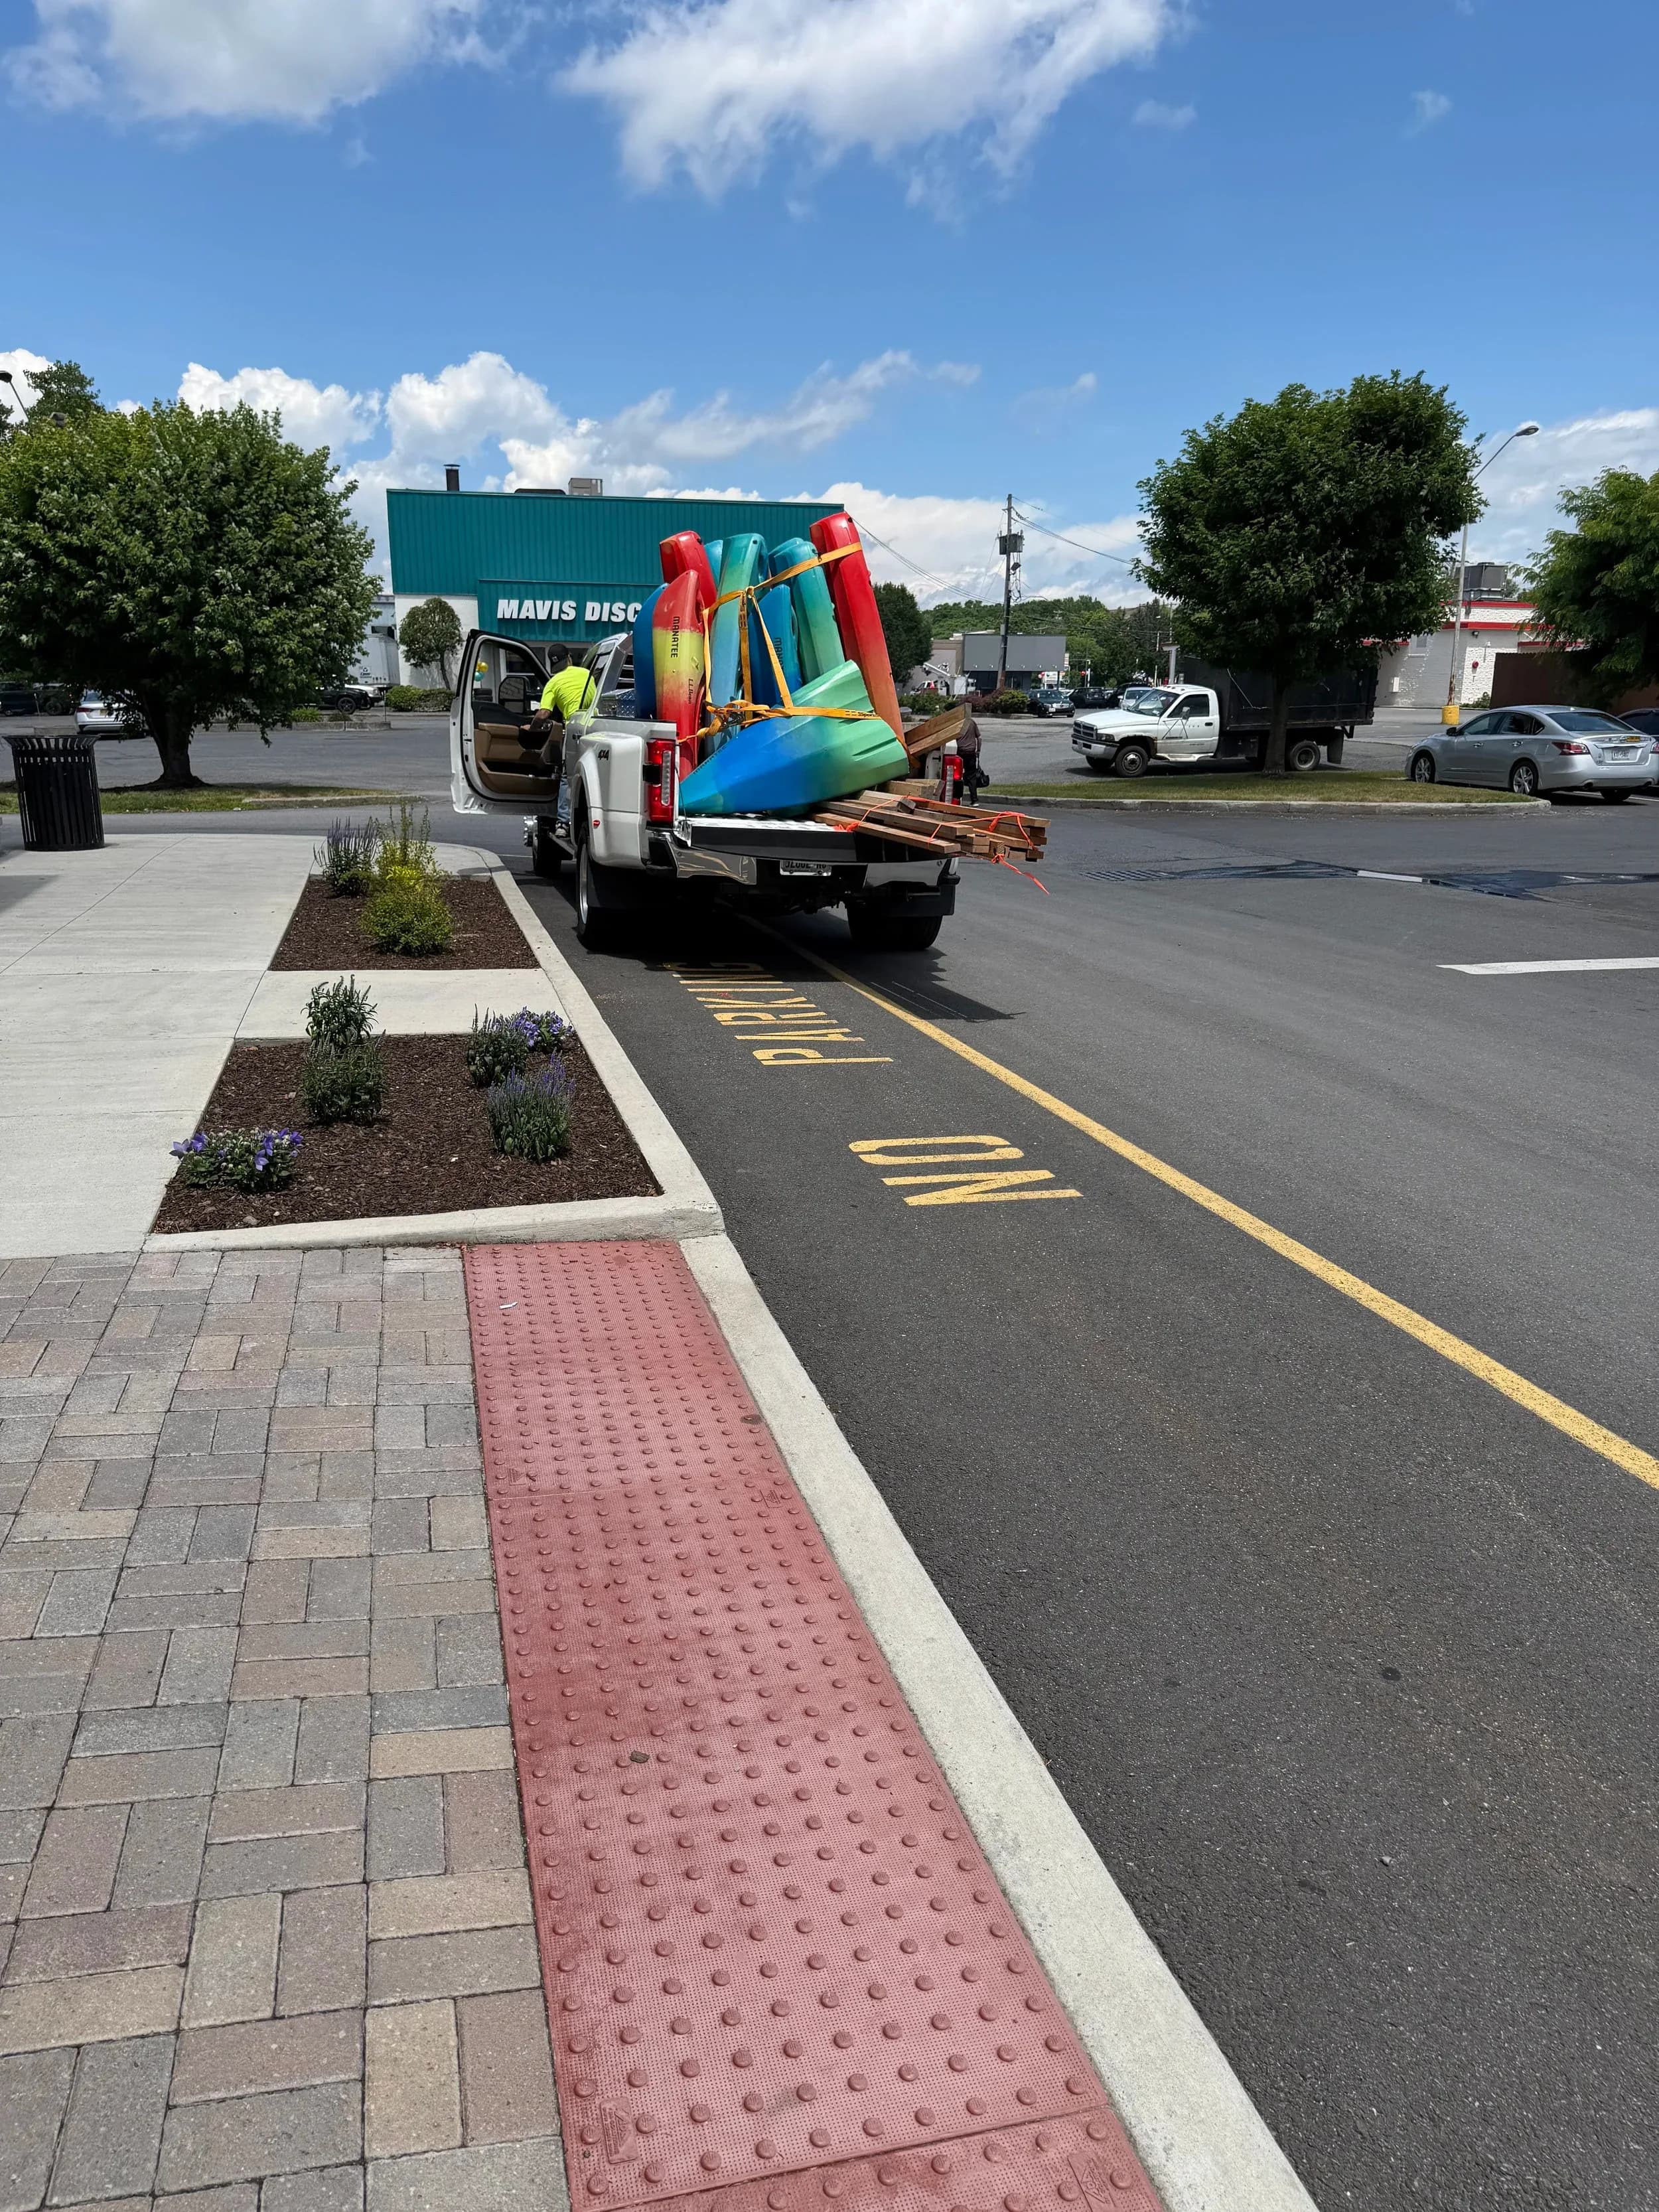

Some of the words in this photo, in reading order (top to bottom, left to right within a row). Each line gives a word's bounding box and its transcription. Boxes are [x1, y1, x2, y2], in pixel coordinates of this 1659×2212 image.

[497, 599, 577, 621] MAVIS
[670, 616, 680, 658] MANATEE
[664, 962, 894, 1065] PARKING
[849, 1135, 1084, 1206] NO
